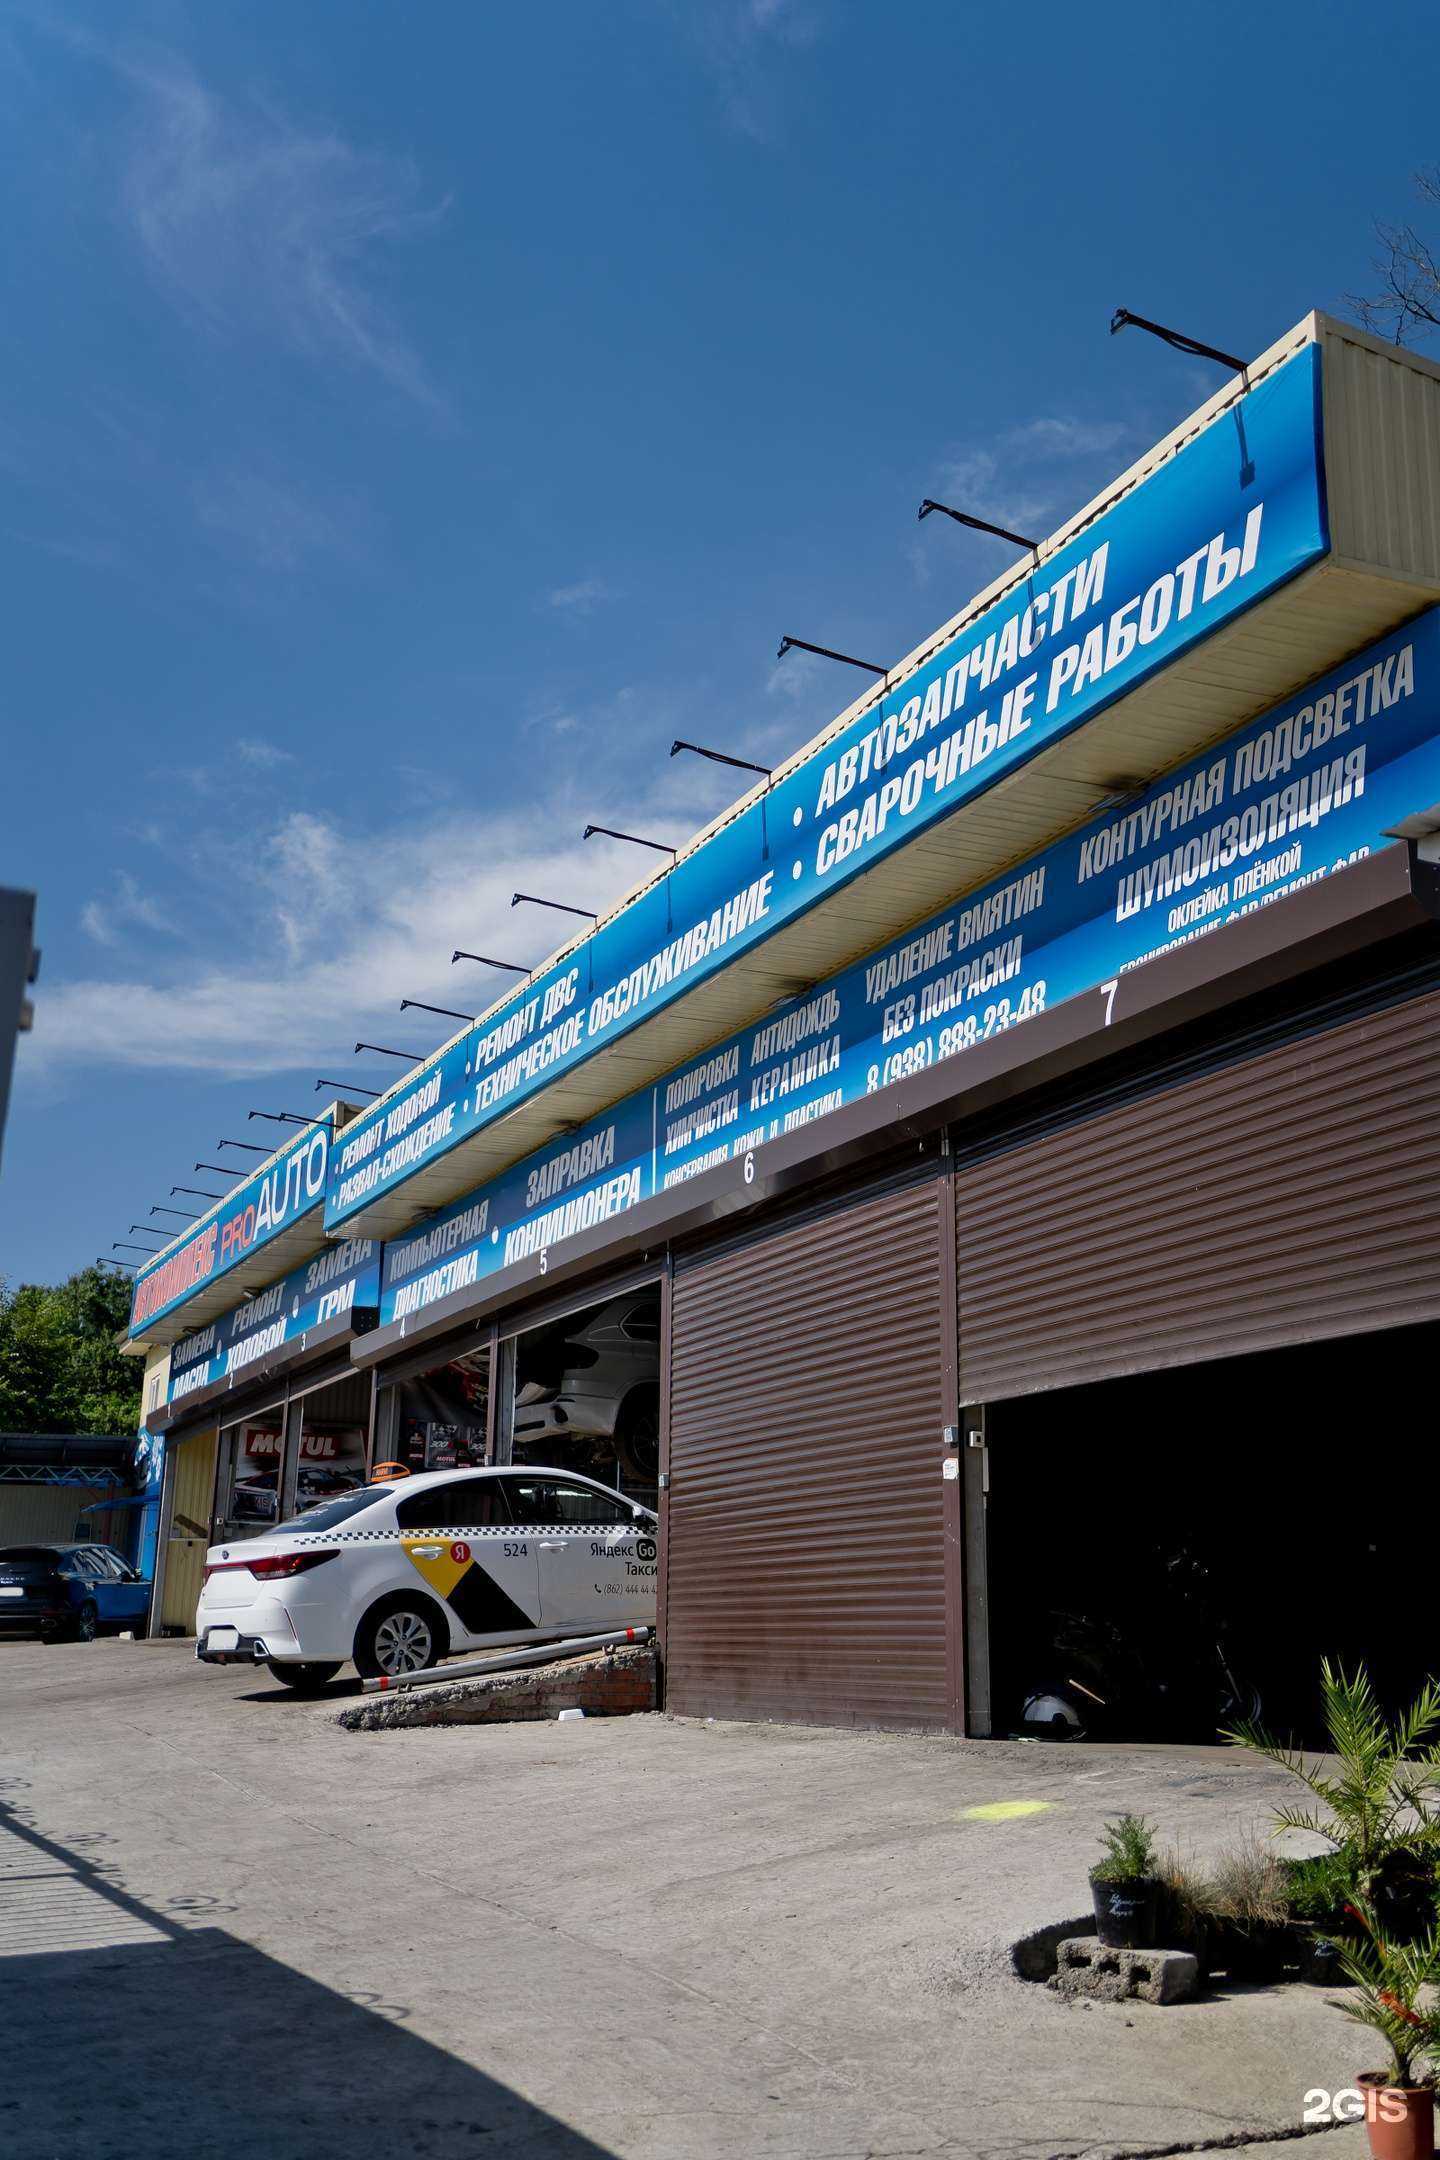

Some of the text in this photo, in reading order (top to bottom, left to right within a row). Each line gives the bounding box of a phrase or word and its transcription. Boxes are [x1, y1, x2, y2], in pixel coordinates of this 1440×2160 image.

[815, 541, 1110, 817] АВТОЗАПЧАСТИ
[815, 502, 1264, 876] СВАРОЧНЫЕ РАБОТЫ
[1078, 644, 1414, 884] КОНТУРНАЯ ПОДСВЕТКА
[1116, 744, 1367, 923] ШУМОИЗОЛЯЦИЯ
[1167, 840, 1302, 933] ОКЛЕЙКА ПЛЁНКОЙ
[865, 920, 954, 1004] УДАЛЕНИЕ
[958, 866, 1045, 951] ВМЯТИН
[474, 870, 774, 1113] ТЕХНИЧЕСКОЕ ОБСЛУЖИВАНИЕ
[475, 967, 578, 1073] РЕМОНТ ДВС
[882, 934, 1023, 1044] БЕЗ ПОКРАСКИ
[1100, 979, 1118, 1026] 7
[751, 988, 840, 1067] АНТИДОЖДЬ
[665, 1045, 739, 1114] ПОЛИРОВКА
[750, 1034, 840, 1112] КЕРАМИКА
[866, 1064, 879, 1093] 8
[337, 1102, 456, 1210] РАЗВАЛ-СХОЖДЕНИЕ
[341, 1068, 442, 1174] РЕМОНТ ХОДОВОЙ
[665, 1089, 738, 1155] ХИМЧИСТКА
[526, 1125, 615, 1208] ЗАПРАВКА
[744, 1152, 754, 1183] 6
[390, 1200, 489, 1282] КОМПЬЮТЕРНАЯ
[503, 1167, 641, 1267] КОНДИЦИОНЕРА
[305, 1239, 372, 1293] ЗАМЕНА
[392, 1250, 479, 1321] ДИАГНОСТИКА
[540, 1249, 547, 1275] 5
[232, 1282, 286, 1337] РЕМОНТ
[316, 1279, 356, 1325] ГРМ
[399, 1317, 405, 1338] 4
[301, 1334, 306, 1351] 3
[249, 1433, 336, 1456] MUL
[504, 1543, 528, 1557] 524
[591, 1543, 634, 1557] Яндекс
[625, 1562, 658, 1576] Такси
[638, 1542, 656, 1558] Go
